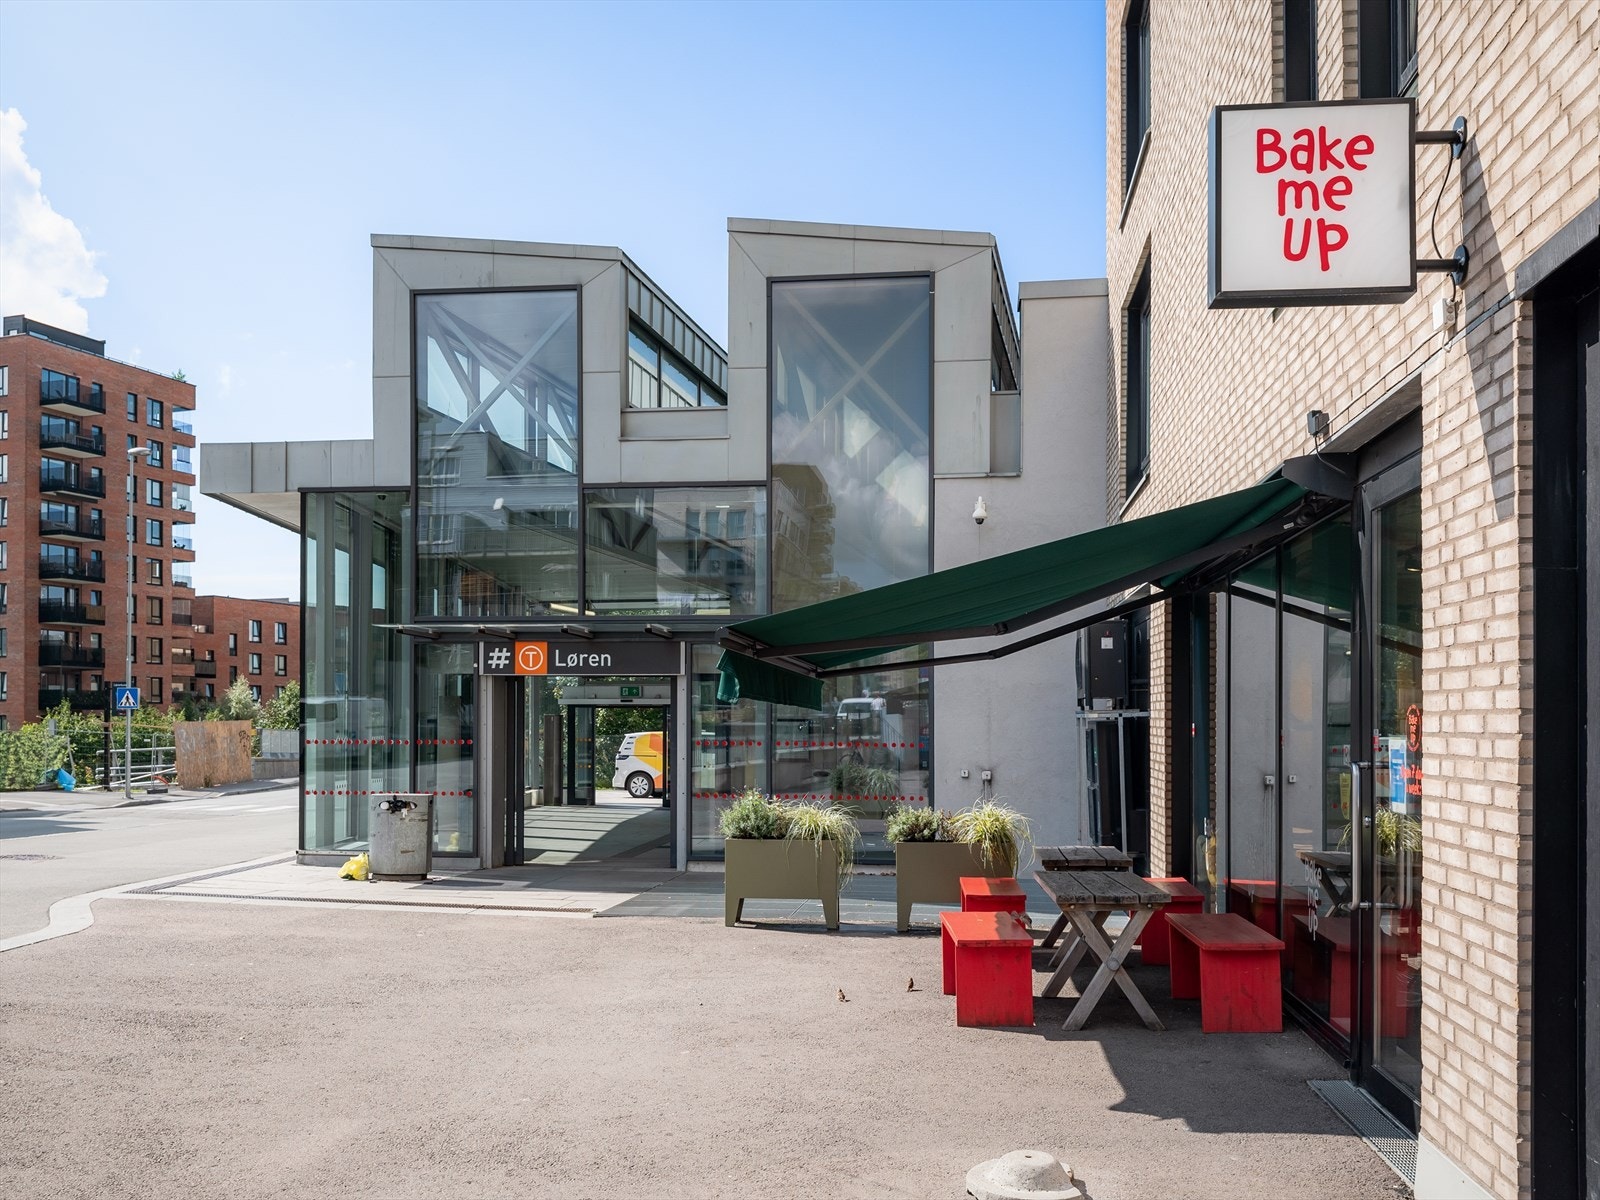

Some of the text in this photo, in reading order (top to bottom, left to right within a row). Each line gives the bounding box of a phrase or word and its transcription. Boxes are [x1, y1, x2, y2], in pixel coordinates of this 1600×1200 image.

[1256, 125, 1375, 174] Bake
[1278, 175, 1353, 217] me
[555, 649, 612, 667] Løren
